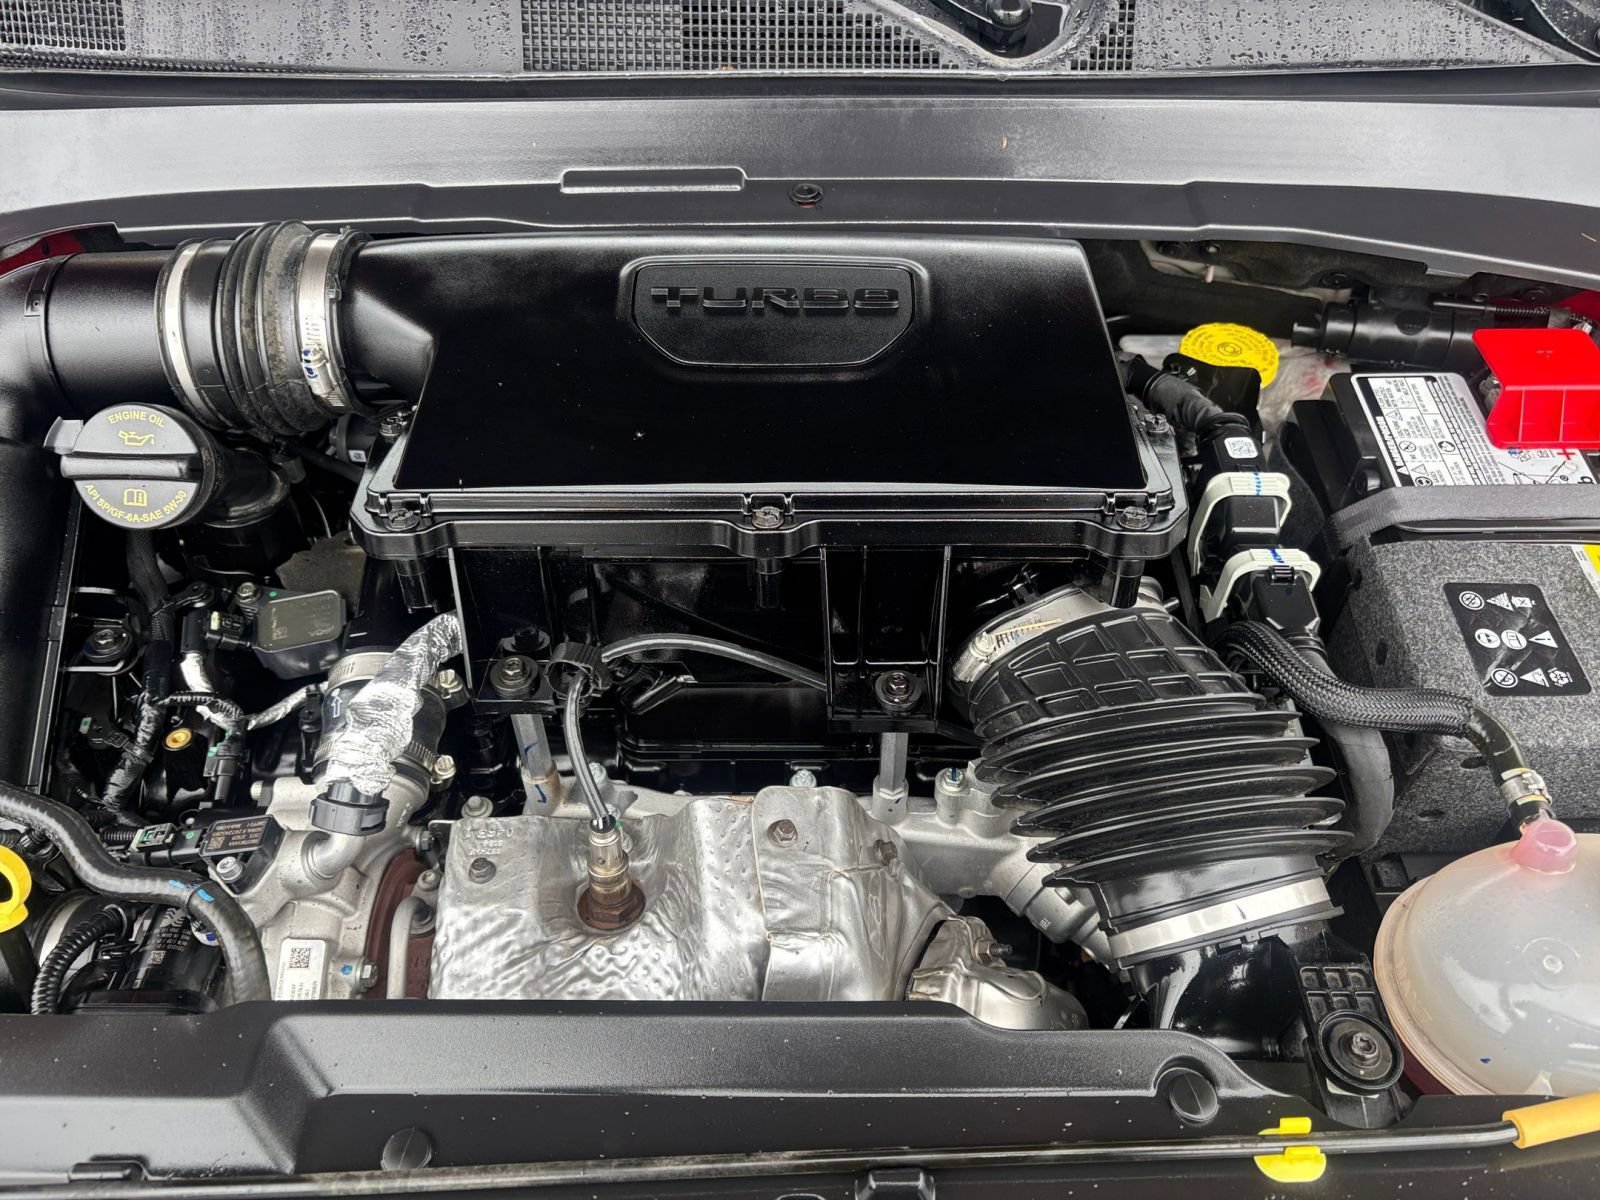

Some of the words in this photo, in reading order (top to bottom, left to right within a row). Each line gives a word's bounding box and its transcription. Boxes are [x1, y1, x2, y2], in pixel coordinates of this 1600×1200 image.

[107, 410, 147, 424] ENGINE
[149, 414, 165, 428] OIL
[84, 484, 100, 500] API
[163, 490, 187, 514] 5W-30
